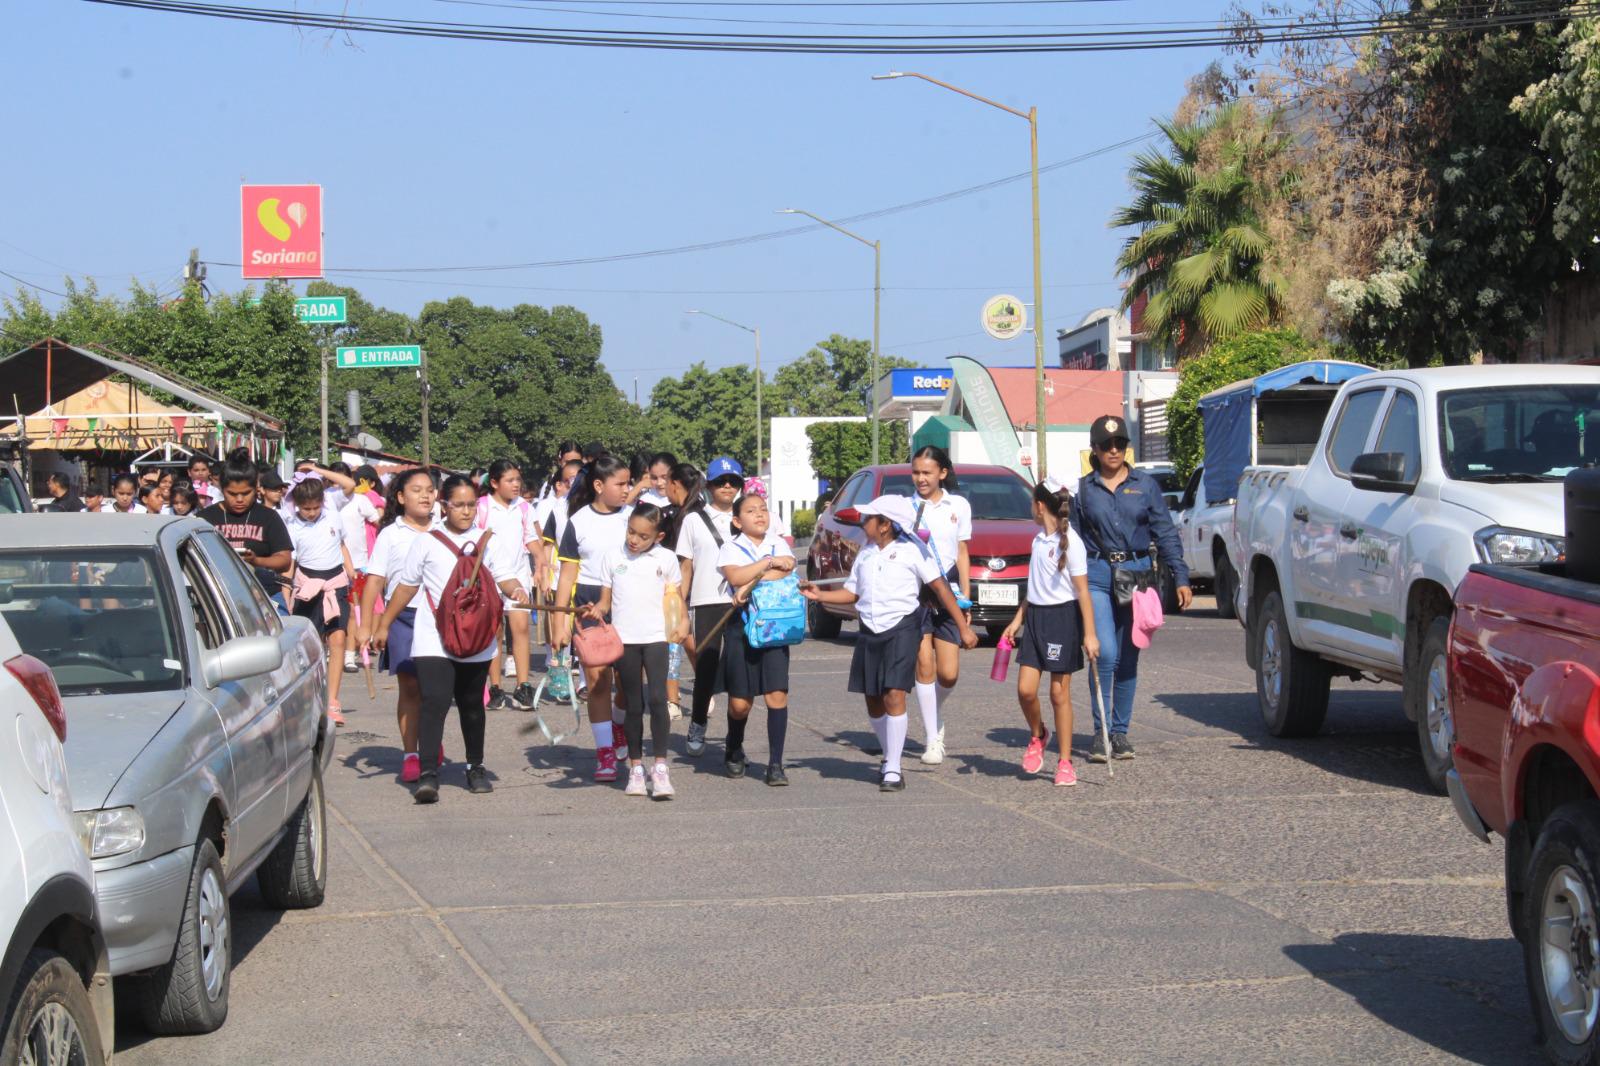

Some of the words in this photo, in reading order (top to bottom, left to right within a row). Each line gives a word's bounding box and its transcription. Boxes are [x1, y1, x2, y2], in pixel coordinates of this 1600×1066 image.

[251, 248, 317, 265] Soriana
[293, 303, 338, 317] TRADA
[361, 350, 414, 363] ENTRADA
[913, 375, 952, 390] Redp
[721, 459, 731, 470] LA
[214, 524, 264, 542] LIFORNIA
